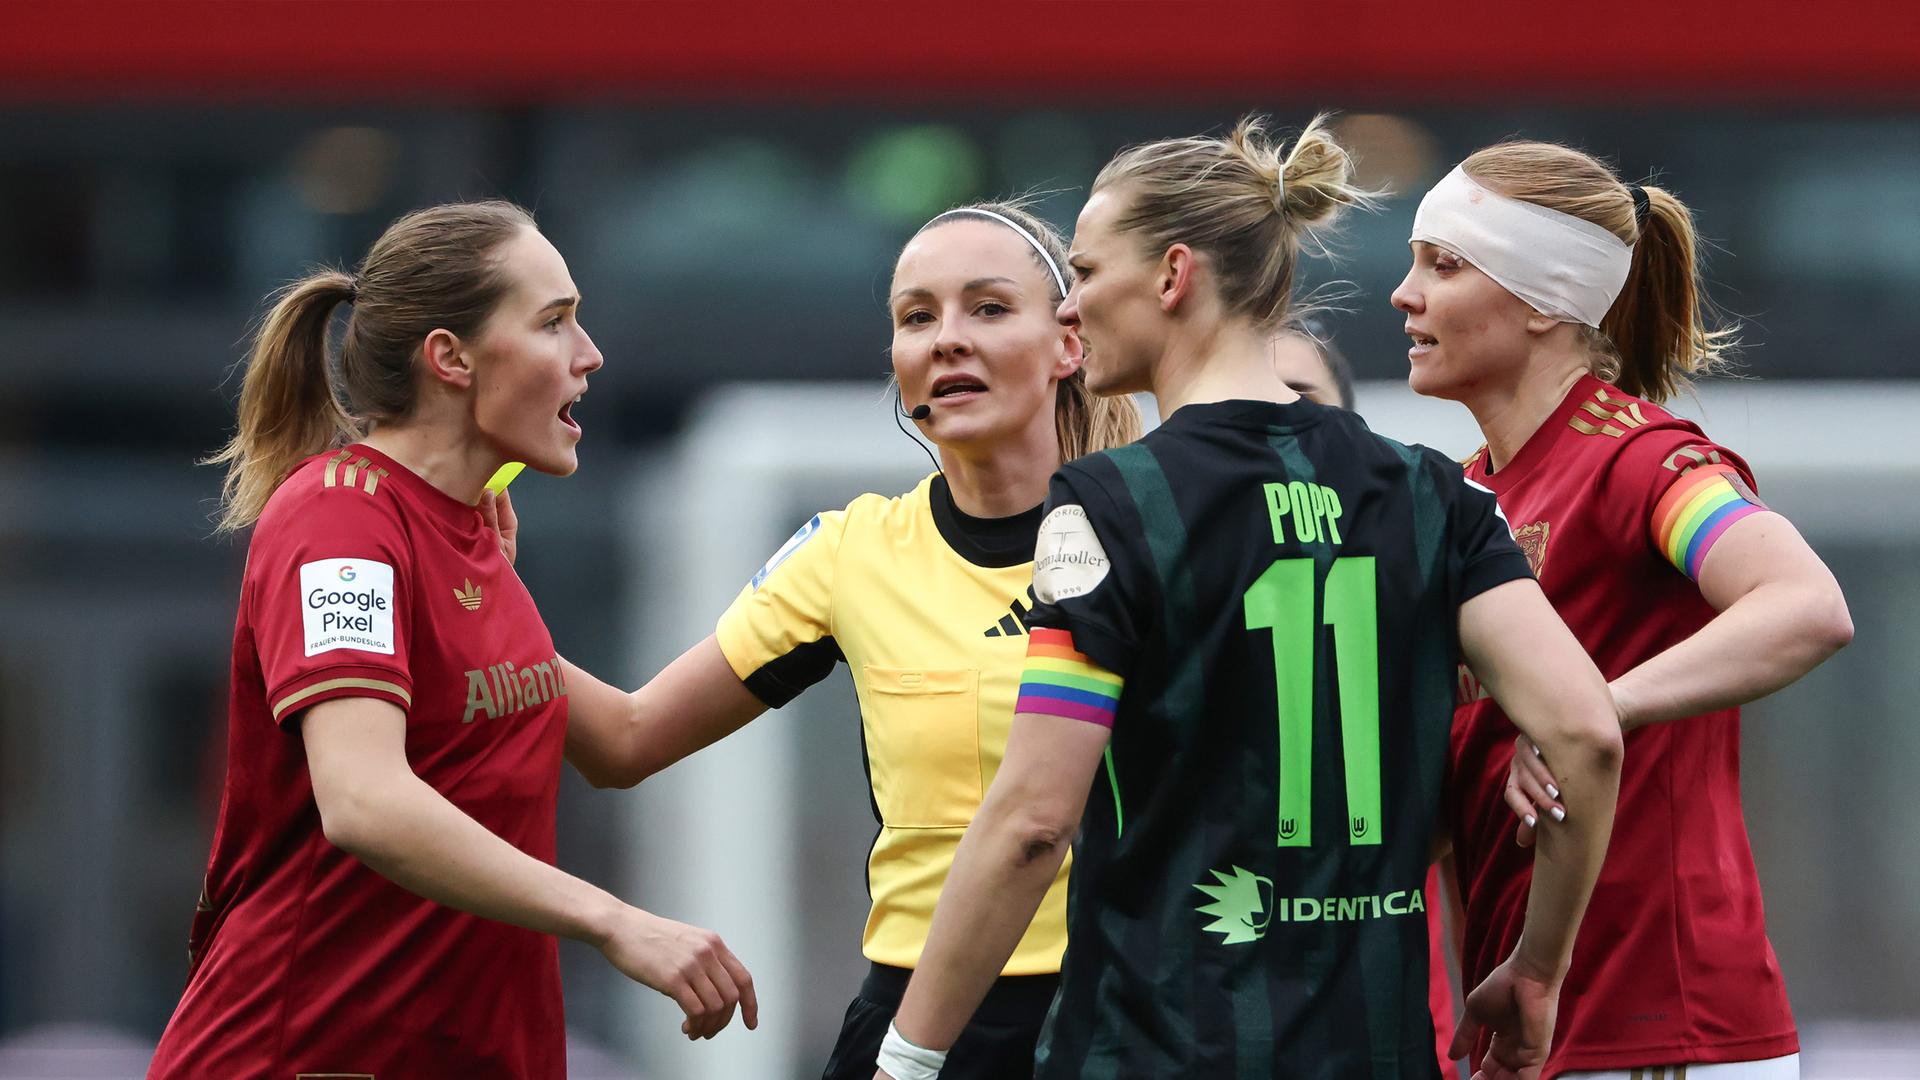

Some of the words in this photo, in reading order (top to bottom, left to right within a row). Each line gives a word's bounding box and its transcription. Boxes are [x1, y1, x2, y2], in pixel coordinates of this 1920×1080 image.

[1263, 481, 1343, 544] POPP
[308, 588, 386, 612] Google
[323, 611, 373, 633] Pixel
[310, 636, 387, 650] FRAUEN-BUNDESLIGA
[462, 658, 568, 724] Allianz
[1243, 556, 1382, 847] 11
[1280, 889, 1425, 922] IDENTICA
